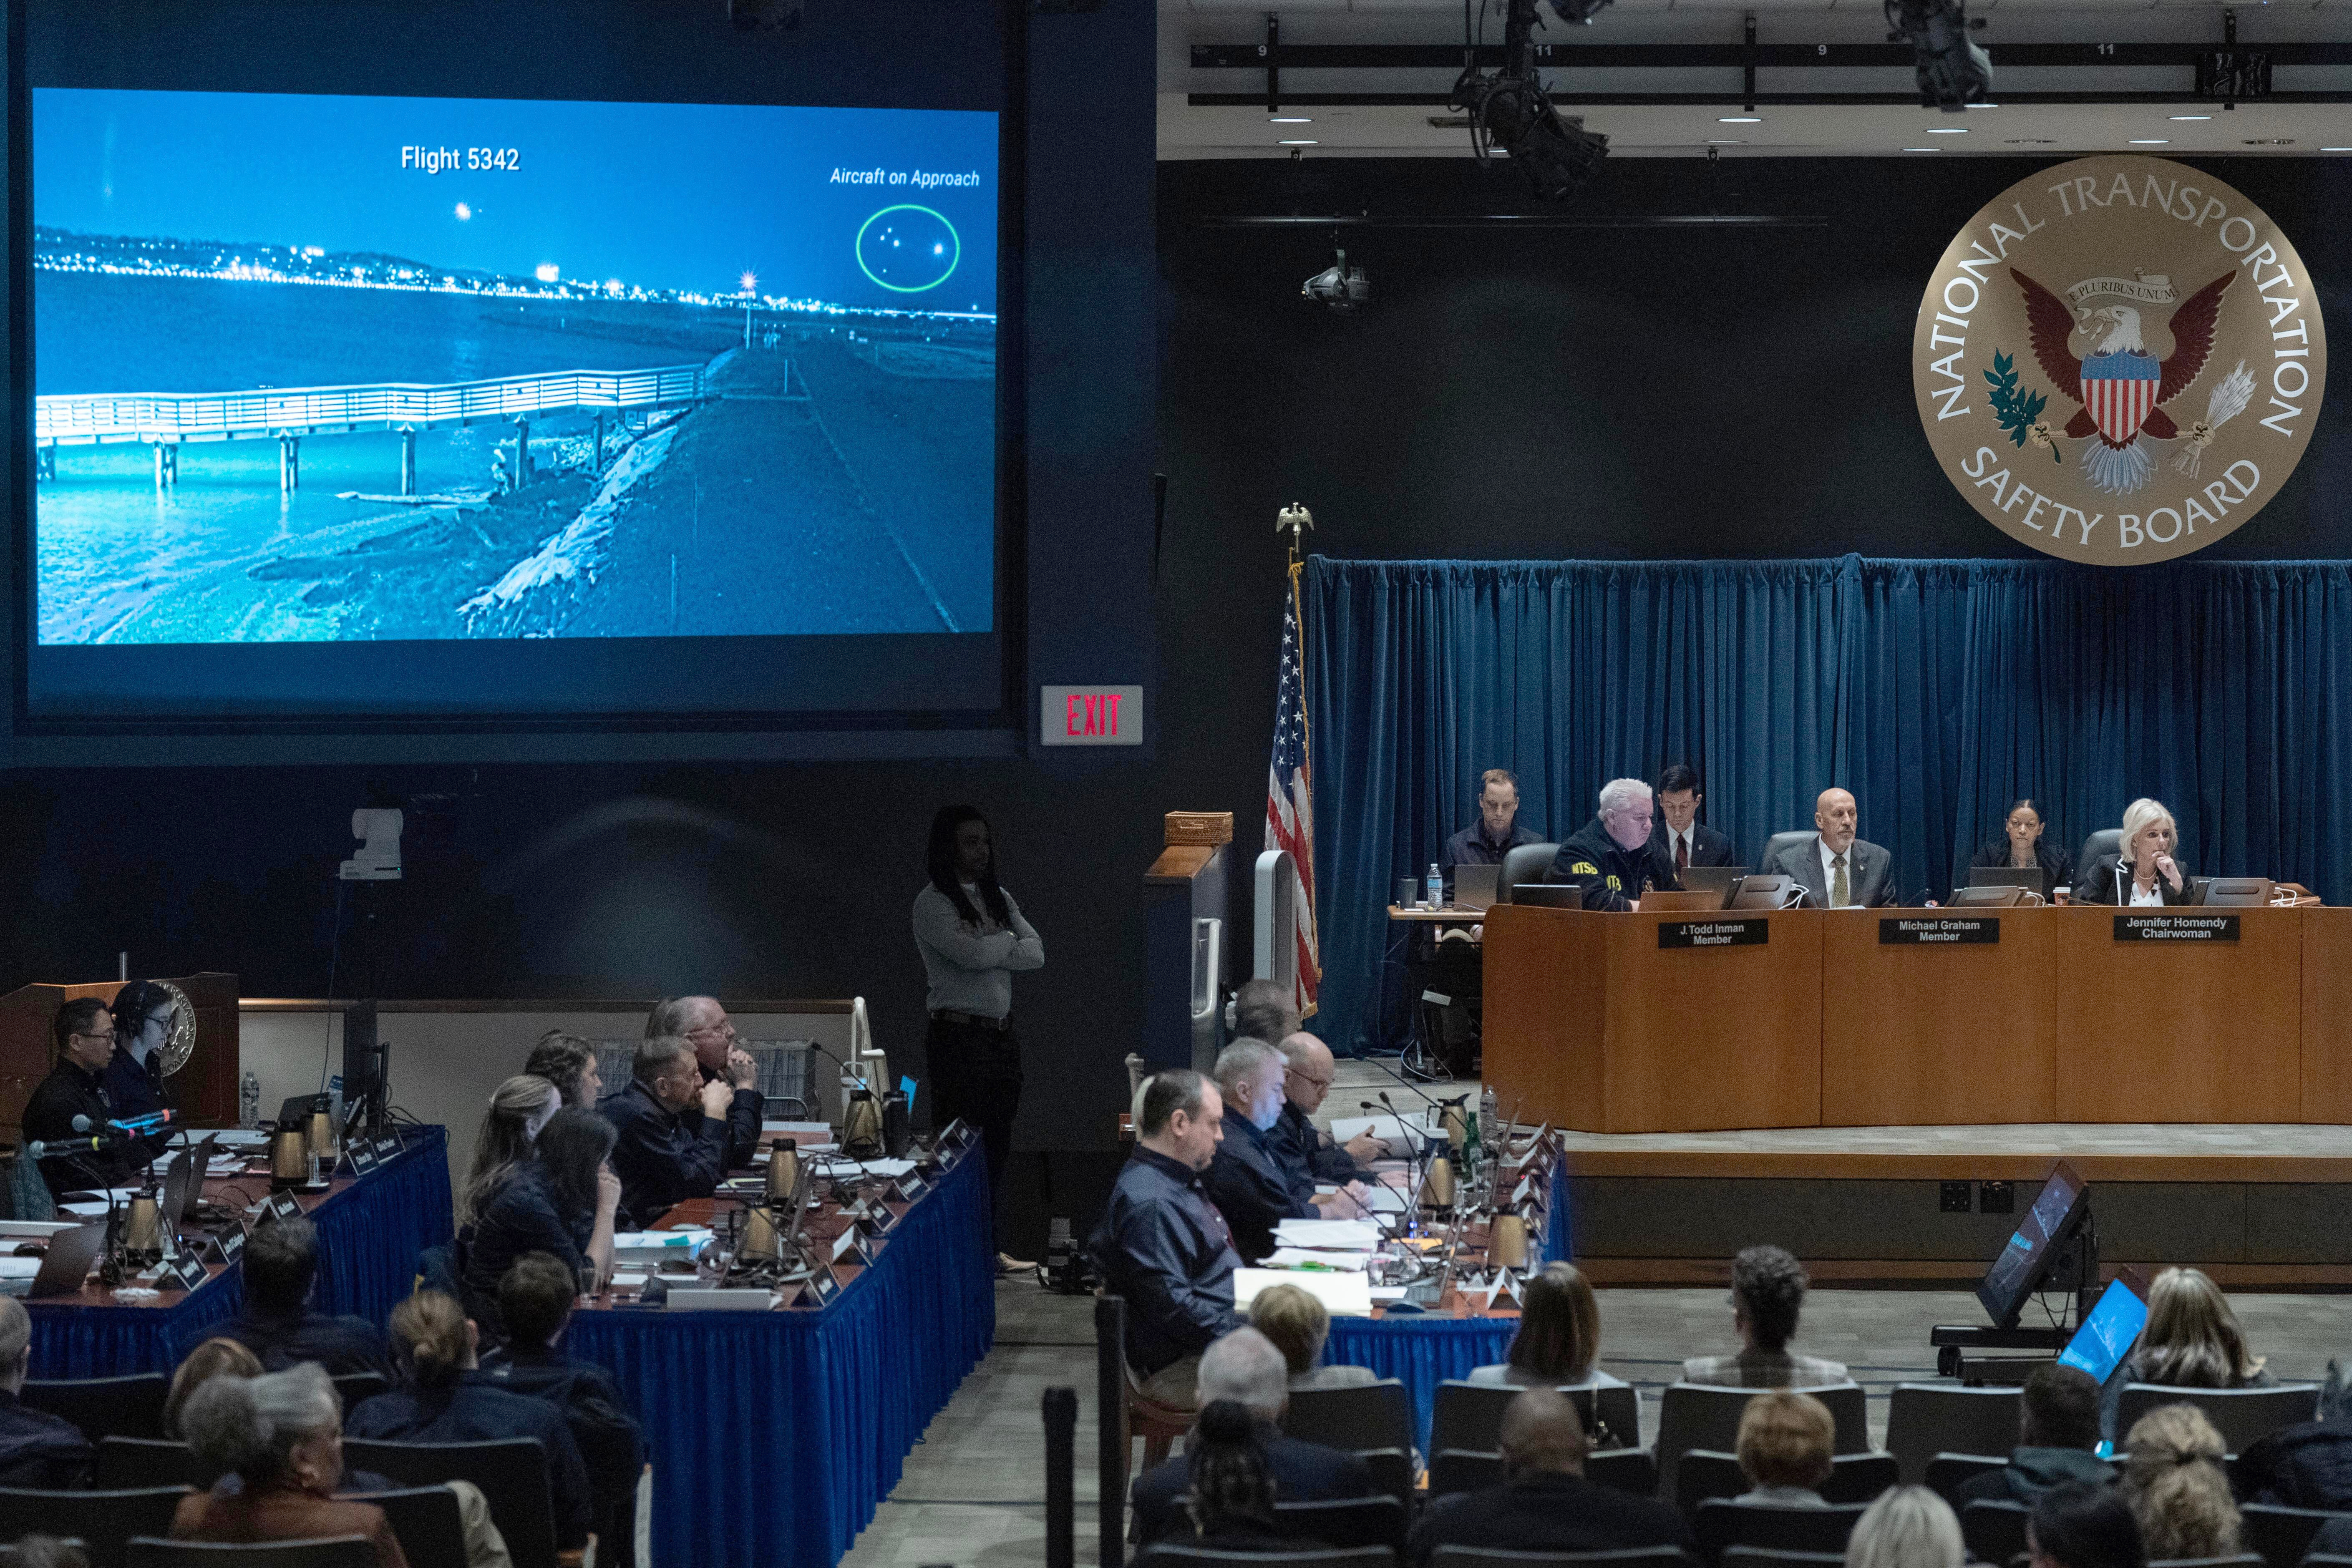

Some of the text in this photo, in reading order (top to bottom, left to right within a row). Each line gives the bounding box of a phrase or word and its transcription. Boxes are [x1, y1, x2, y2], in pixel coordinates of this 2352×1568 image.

[1258, 45, 1267, 56] 9
[1536, 45, 1551, 56] 11
[1818, 44, 1827, 55] 9
[2098, 44, 2113, 55] 11
[402, 146, 520, 174] Flight 5342
[830, 167, 980, 189] Aircraft on Approach
[2069, 282, 2176, 302] E PLURIBUS UNUM
[1931, 173, 2309, 438] NATIONAL TRANSPORTATION
[1960, 446, 2261, 549] SAFETY BOARD
[1067, 695, 1122, 736] EXIT
[1899, 920, 1980, 930] Michael Graham
[2127, 917, 2227, 929] Jennifer Homendy
[1680, 924, 1745, 935] J. Todd Inman
[2142, 928, 2211, 938] Chairwoman
[1693, 935, 1733, 945] Member
[1919, 931, 1960, 941] Member
